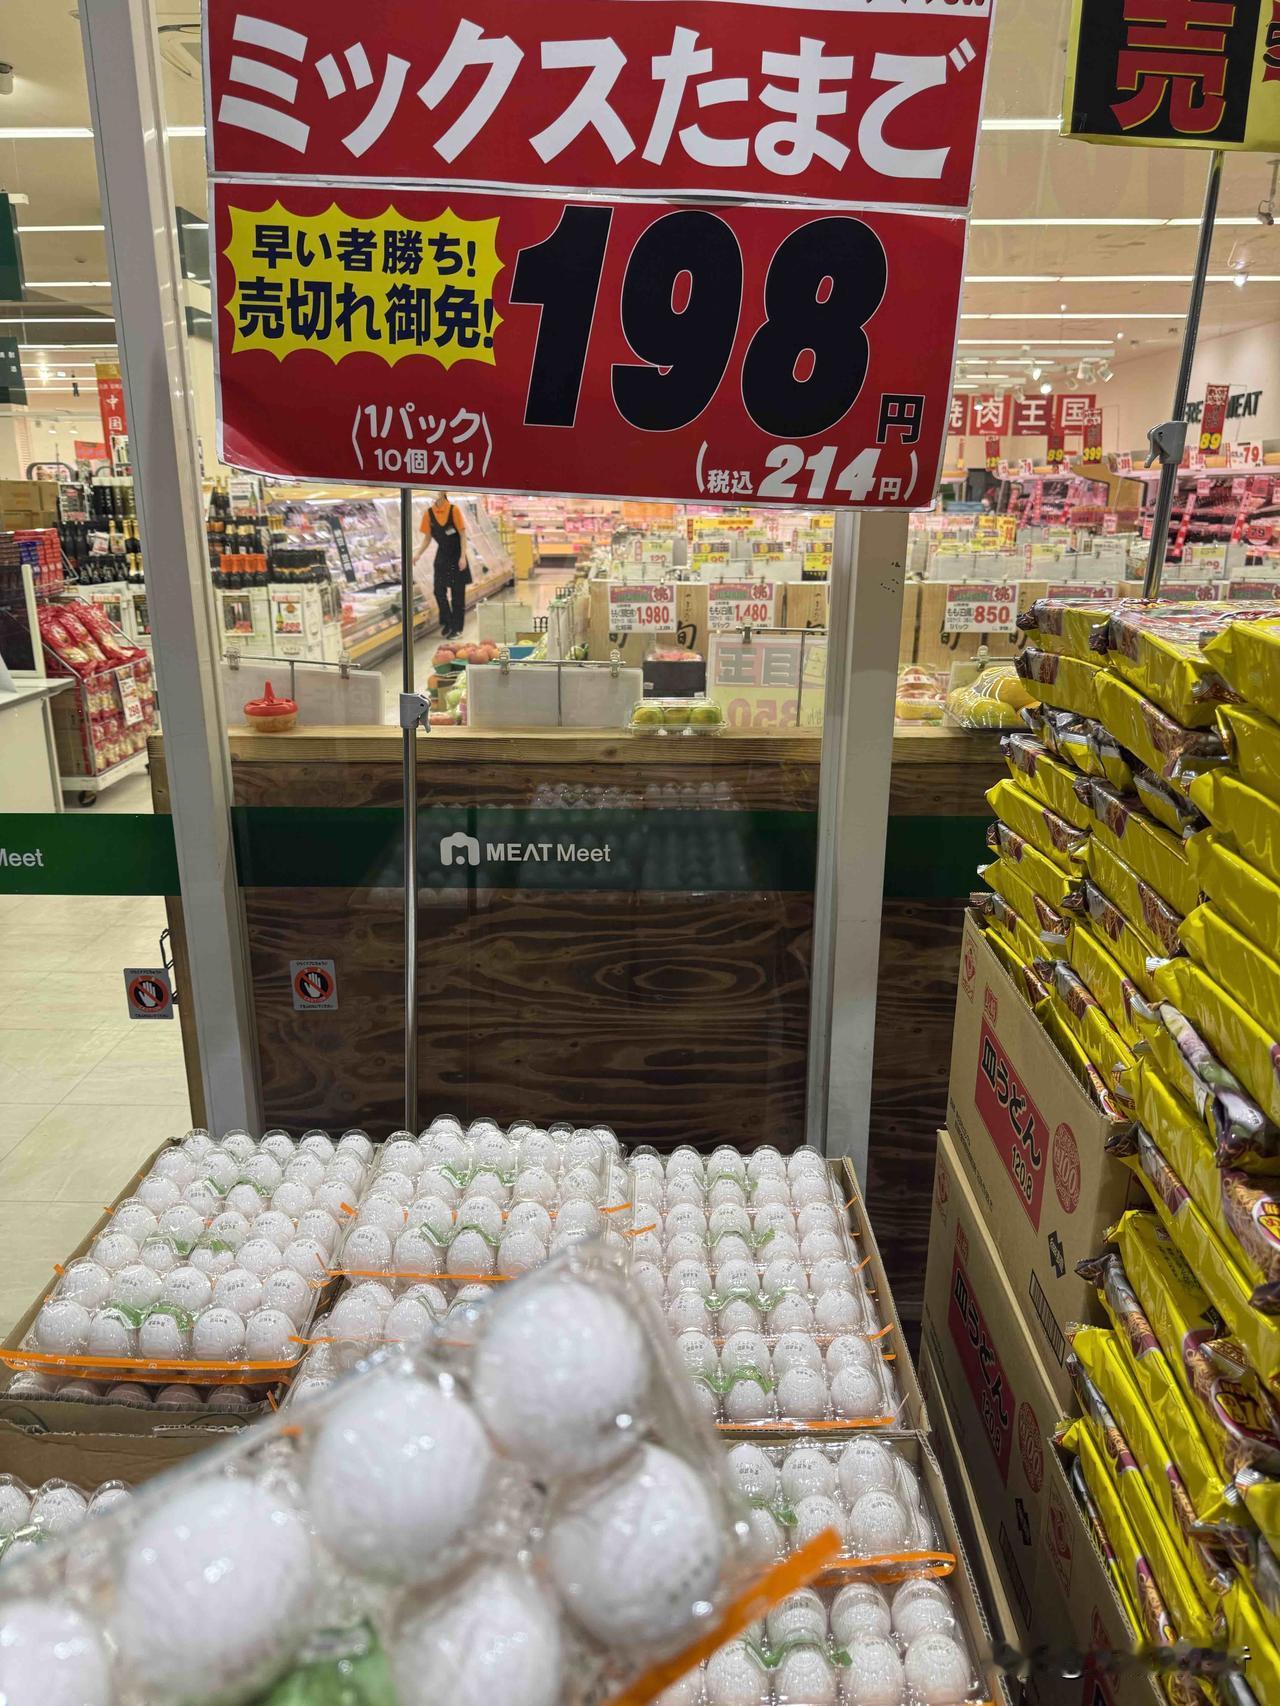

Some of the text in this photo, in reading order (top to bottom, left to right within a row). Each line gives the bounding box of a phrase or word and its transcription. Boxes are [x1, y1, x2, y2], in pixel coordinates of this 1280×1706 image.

[1110, 0, 1236, 134] 売
[252, 225, 476, 277] 早い者勝ち!
[238, 276, 494, 349] 売切れ御免!
[1200, 433, 1221, 449] 89
[1243, 446, 1259, 463] 79
[374, 448, 474, 477] 10個入り
[637, 606, 669, 625] 1,980
[736, 604, 767, 623] 1,480
[975, 605, 1009, 623] 850
[487, 844, 611, 862] MEAT Meet
[982, 1036, 1043, 1171] 皿うどん
[1011, 1144, 1034, 1206] 120.8
[955, 1267, 1009, 1430] 皿うどん
